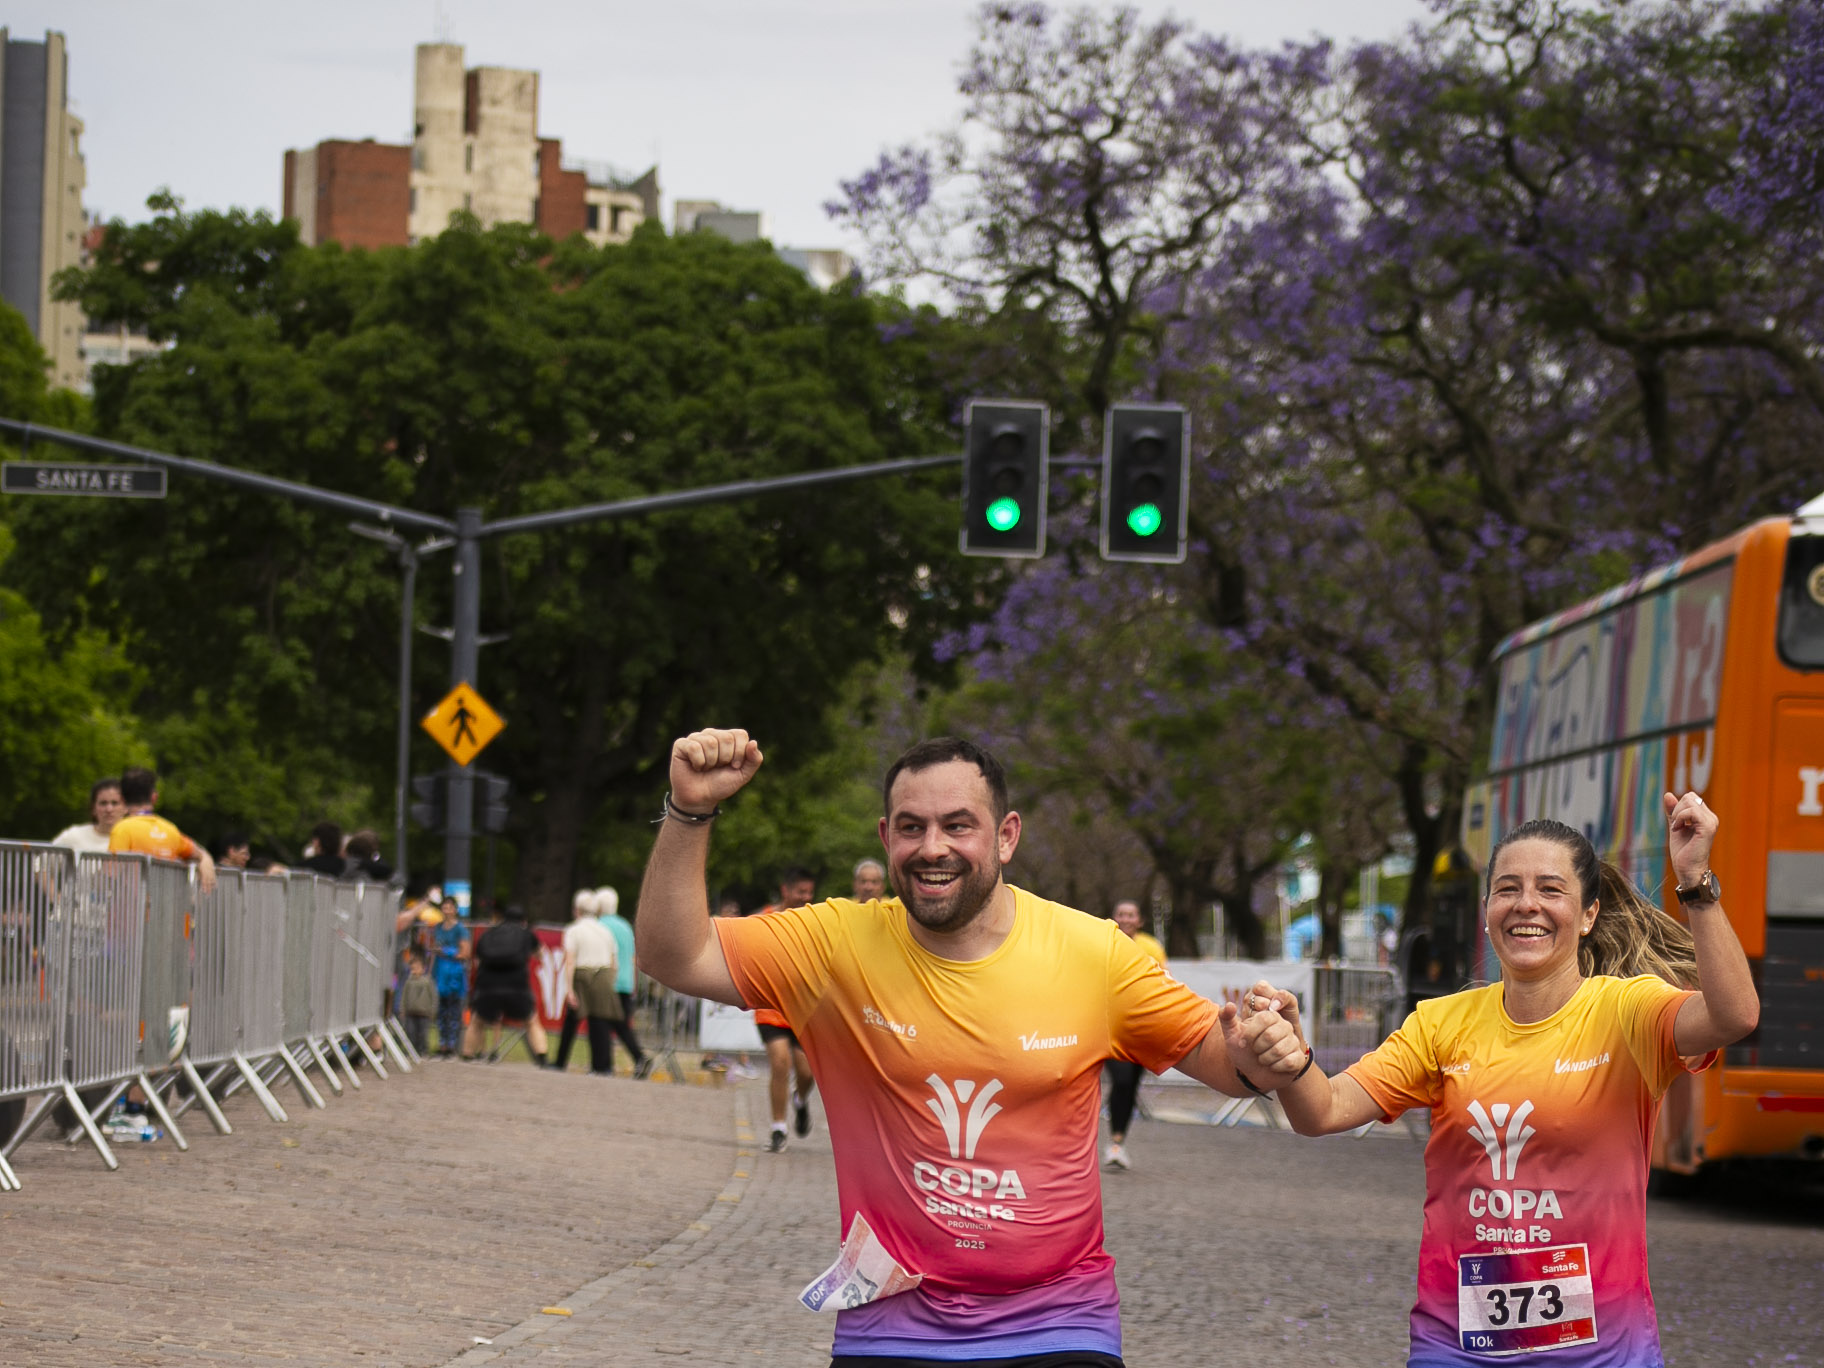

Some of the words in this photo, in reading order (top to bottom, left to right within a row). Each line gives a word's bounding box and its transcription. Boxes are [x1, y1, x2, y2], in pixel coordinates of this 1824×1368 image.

[35, 469, 103, 490] SANTA
[107, 472, 133, 492] FE
[907, 1024, 917, 1038] 6
[1017, 1029, 1078, 1051] VANDALIA
[1554, 1052, 1610, 1074] VANDALIA
[913, 1161, 1027, 1200] COPA
[925, 1196, 988, 1219] Santa
[989, 1204, 1016, 1222] Fe
[1468, 1187, 1564, 1220] COPA
[947, 1220, 993, 1231] PROVINCIA
[1475, 1223, 1526, 1243] Santa
[1528, 1225, 1552, 1243] Fe
[955, 1238, 986, 1250] 2025
[1541, 1264, 1568, 1274] Santa
[1568, 1262, 1579, 1272] Fe
[1486, 1284, 1564, 1326] 373
[1470, 1335, 1494, 1348] 10k
